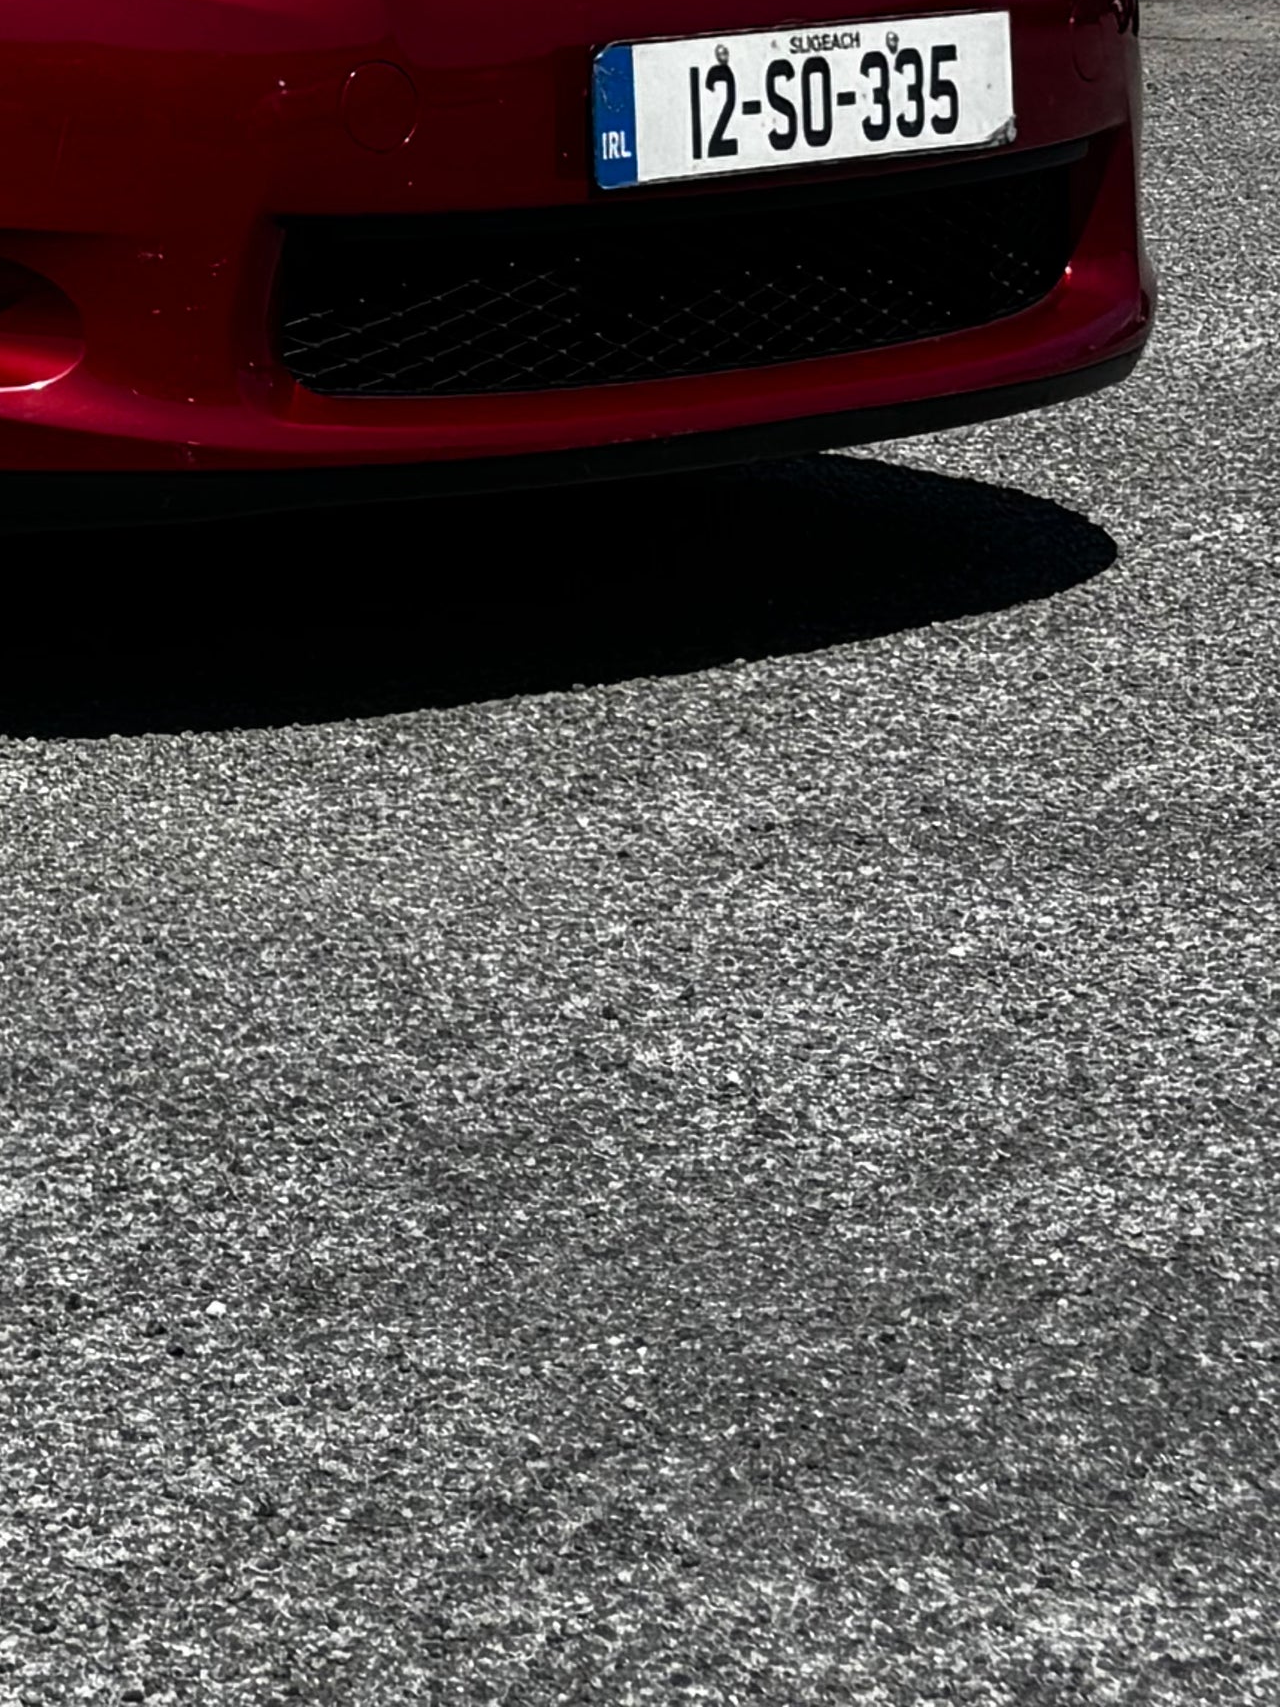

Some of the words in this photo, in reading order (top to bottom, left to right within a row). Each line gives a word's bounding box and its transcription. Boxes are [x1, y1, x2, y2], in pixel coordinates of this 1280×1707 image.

[788, 32, 862, 54] SLIGEACH
[688, 44, 960, 161] 12-SO-335
[601, 131, 632, 161] IRL
